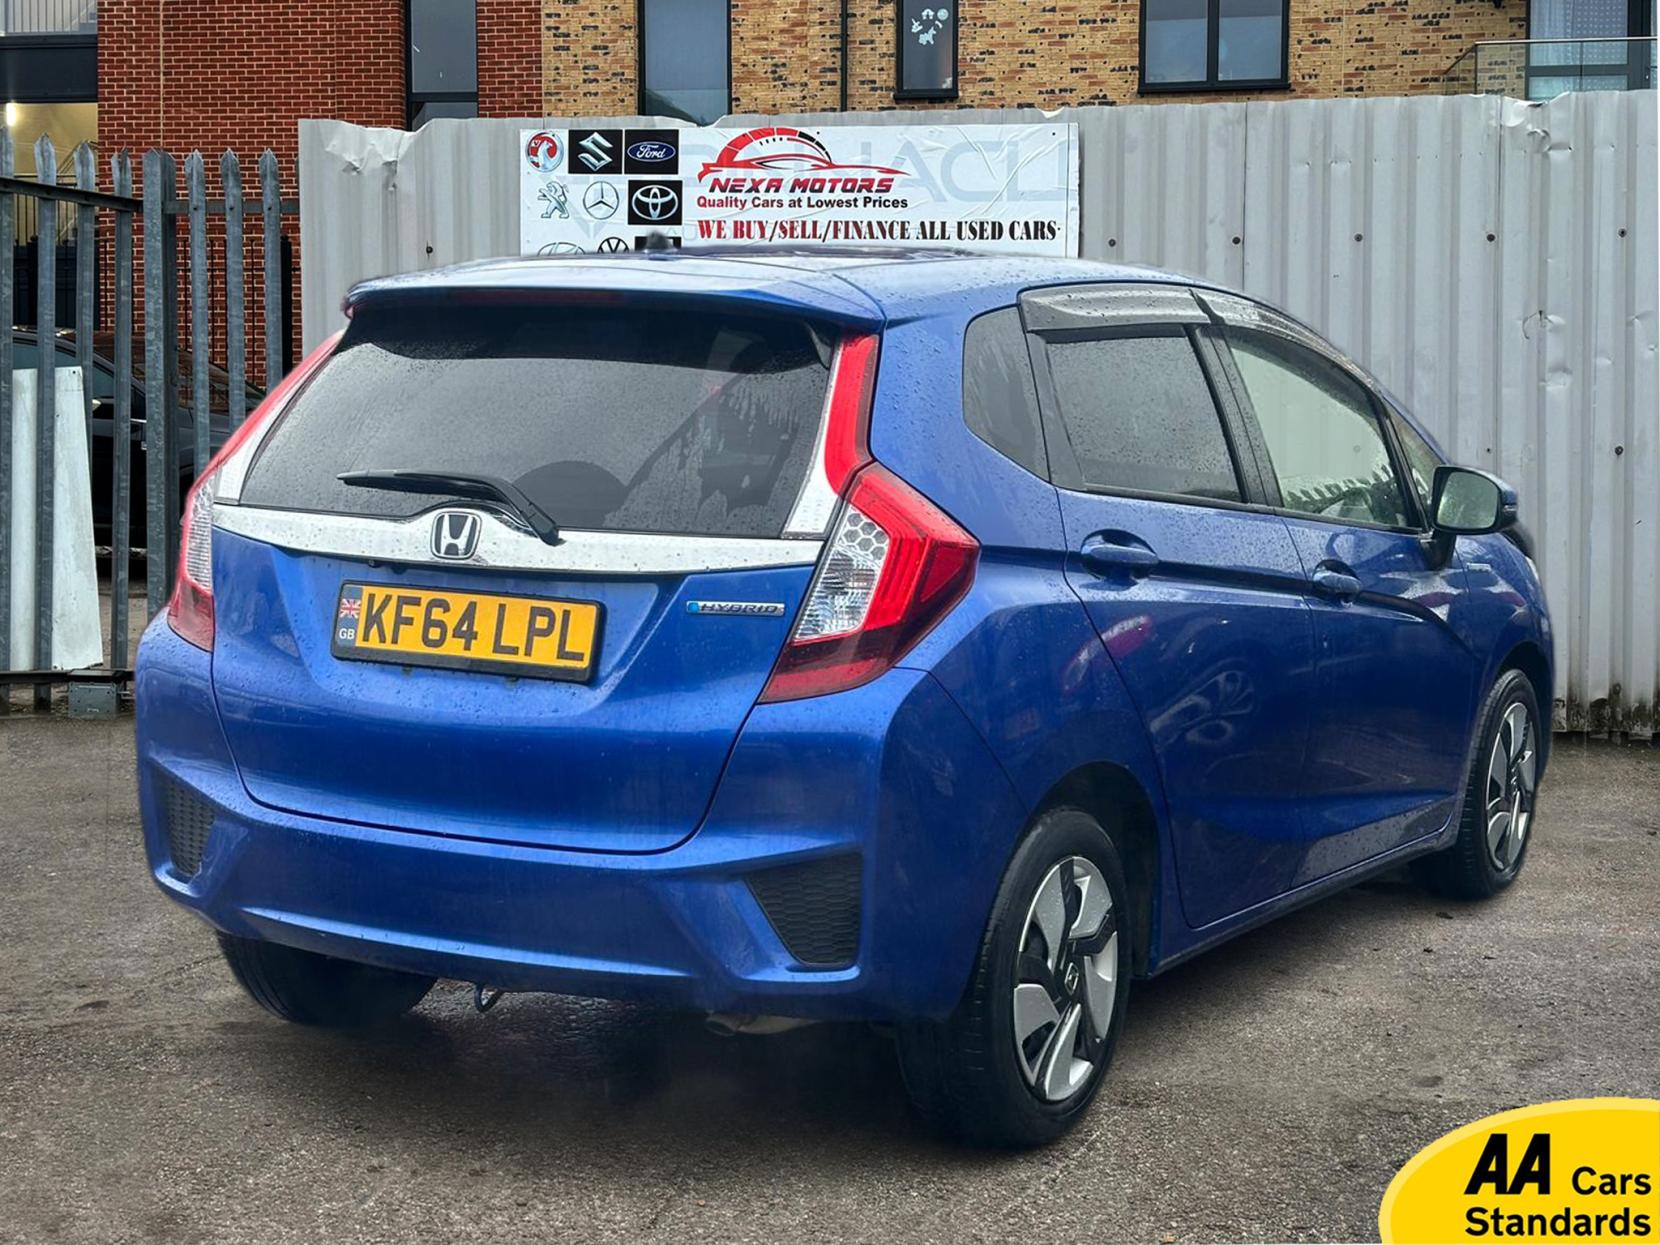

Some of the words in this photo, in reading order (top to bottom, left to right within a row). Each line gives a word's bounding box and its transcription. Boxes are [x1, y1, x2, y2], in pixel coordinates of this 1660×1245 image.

[636, 144, 667, 159] Ford
[709, 177, 784, 194] NEXA
[789, 177, 895, 194] MOTORS
[697, 196, 748, 211] Quality
[752, 196, 784, 209] Cars
[788, 196, 803, 209] at
[807, 196, 859, 209] Lowest
[863, 195, 909, 209] Prices
[697, 219, 727, 240] WE
[732, 219, 911, 243] BUY/SELL/FINANCE
[916, 220, 951, 241] ALL
[956, 220, 1004, 241] USED
[1008, 220, 1057, 241] CARS
[701, 603, 779, 614] HYBRID
[338, 627, 356, 641] GB
[361, 592, 479, 652] KF64
[492, 603, 585, 662] LPL
